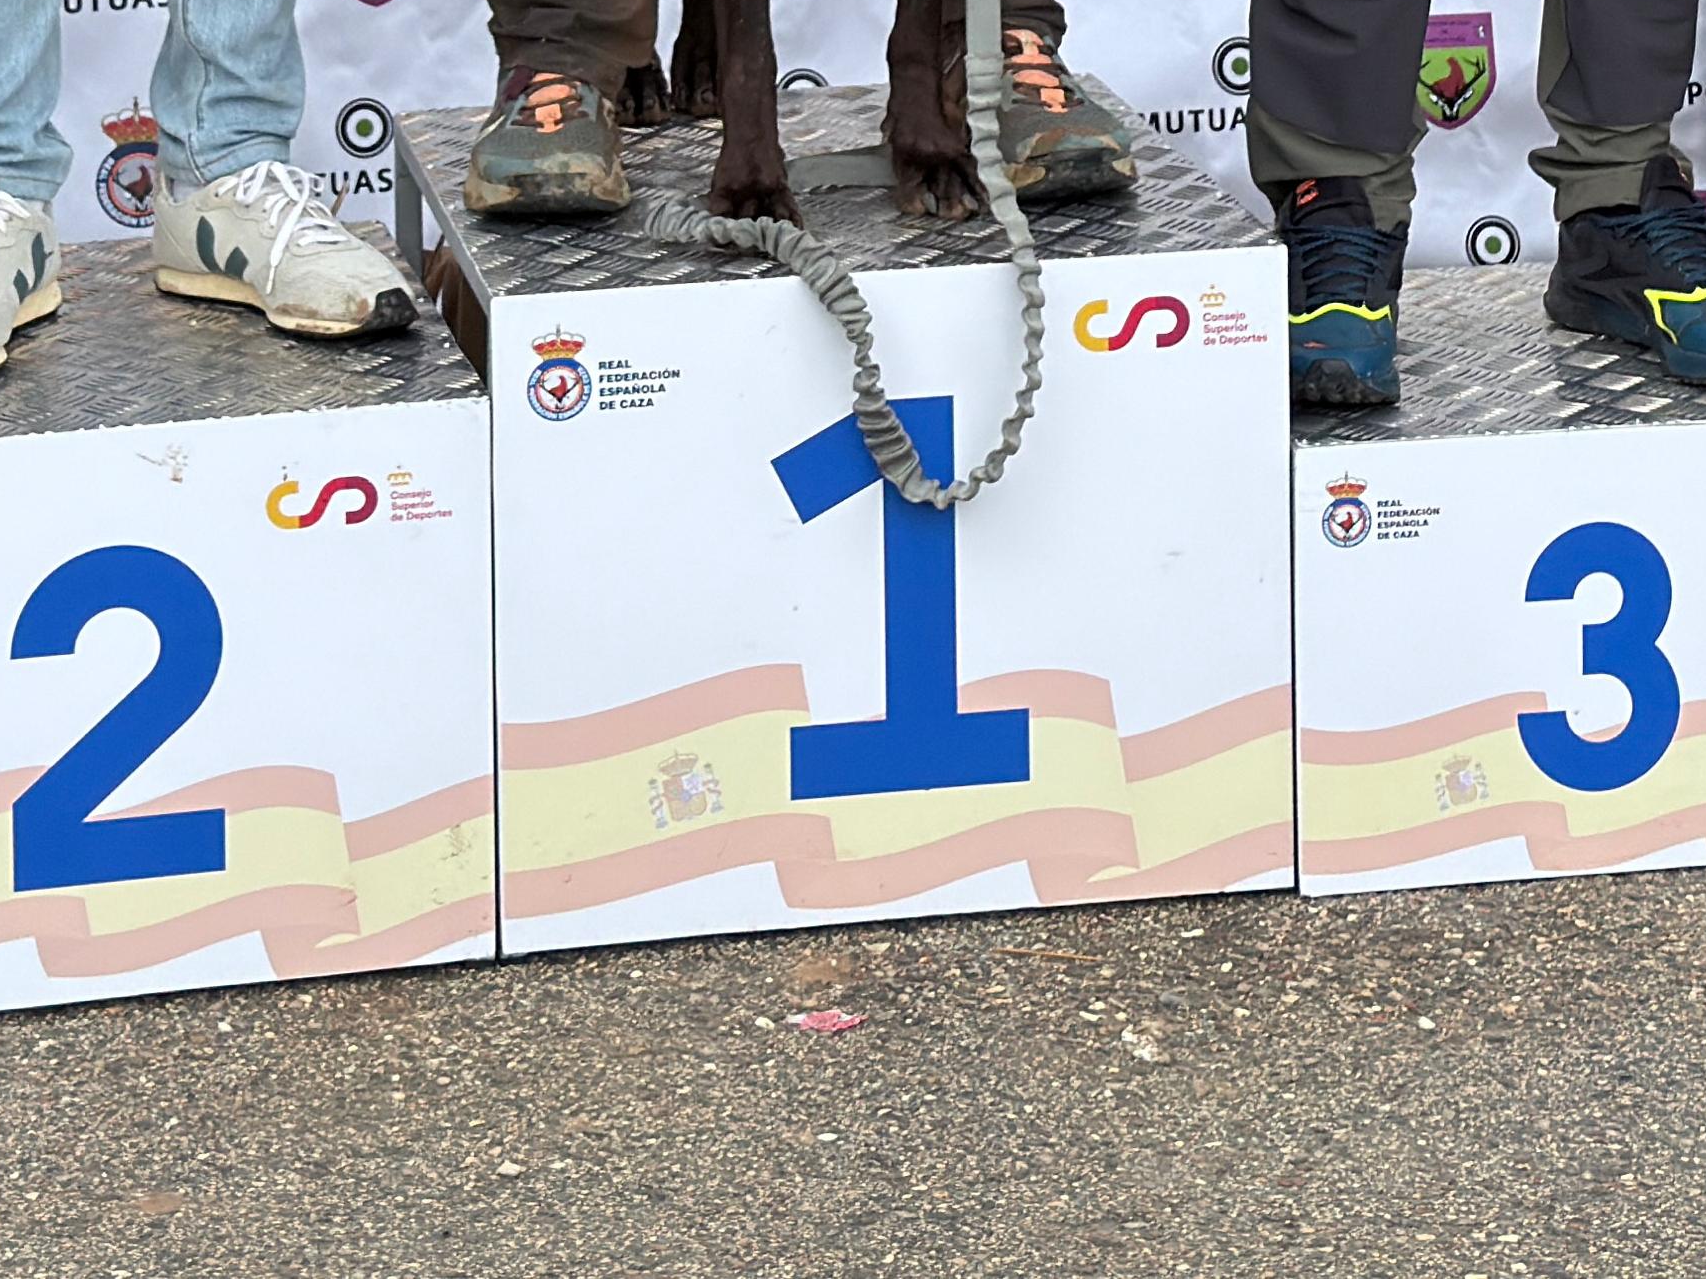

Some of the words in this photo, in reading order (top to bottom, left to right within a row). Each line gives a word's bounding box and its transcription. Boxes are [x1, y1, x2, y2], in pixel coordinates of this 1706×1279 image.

[1203, 336, 1216, 346] de
[1219, 333, 1268, 346] Deportes
[598, 360, 632, 370] REAL
[599, 368, 681, 383] FEDERACIÓN
[599, 383, 666, 397] ESPAÑOLA
[599, 401, 616, 410] DE
[620, 398, 654, 409] CAZA
[1377, 500, 1403, 508] REAL
[1377, 532, 1390, 540] DE
[771, 394, 1030, 801] 1
[1517, 521, 1681, 792] 3
[10, 544, 226, 892] 2
